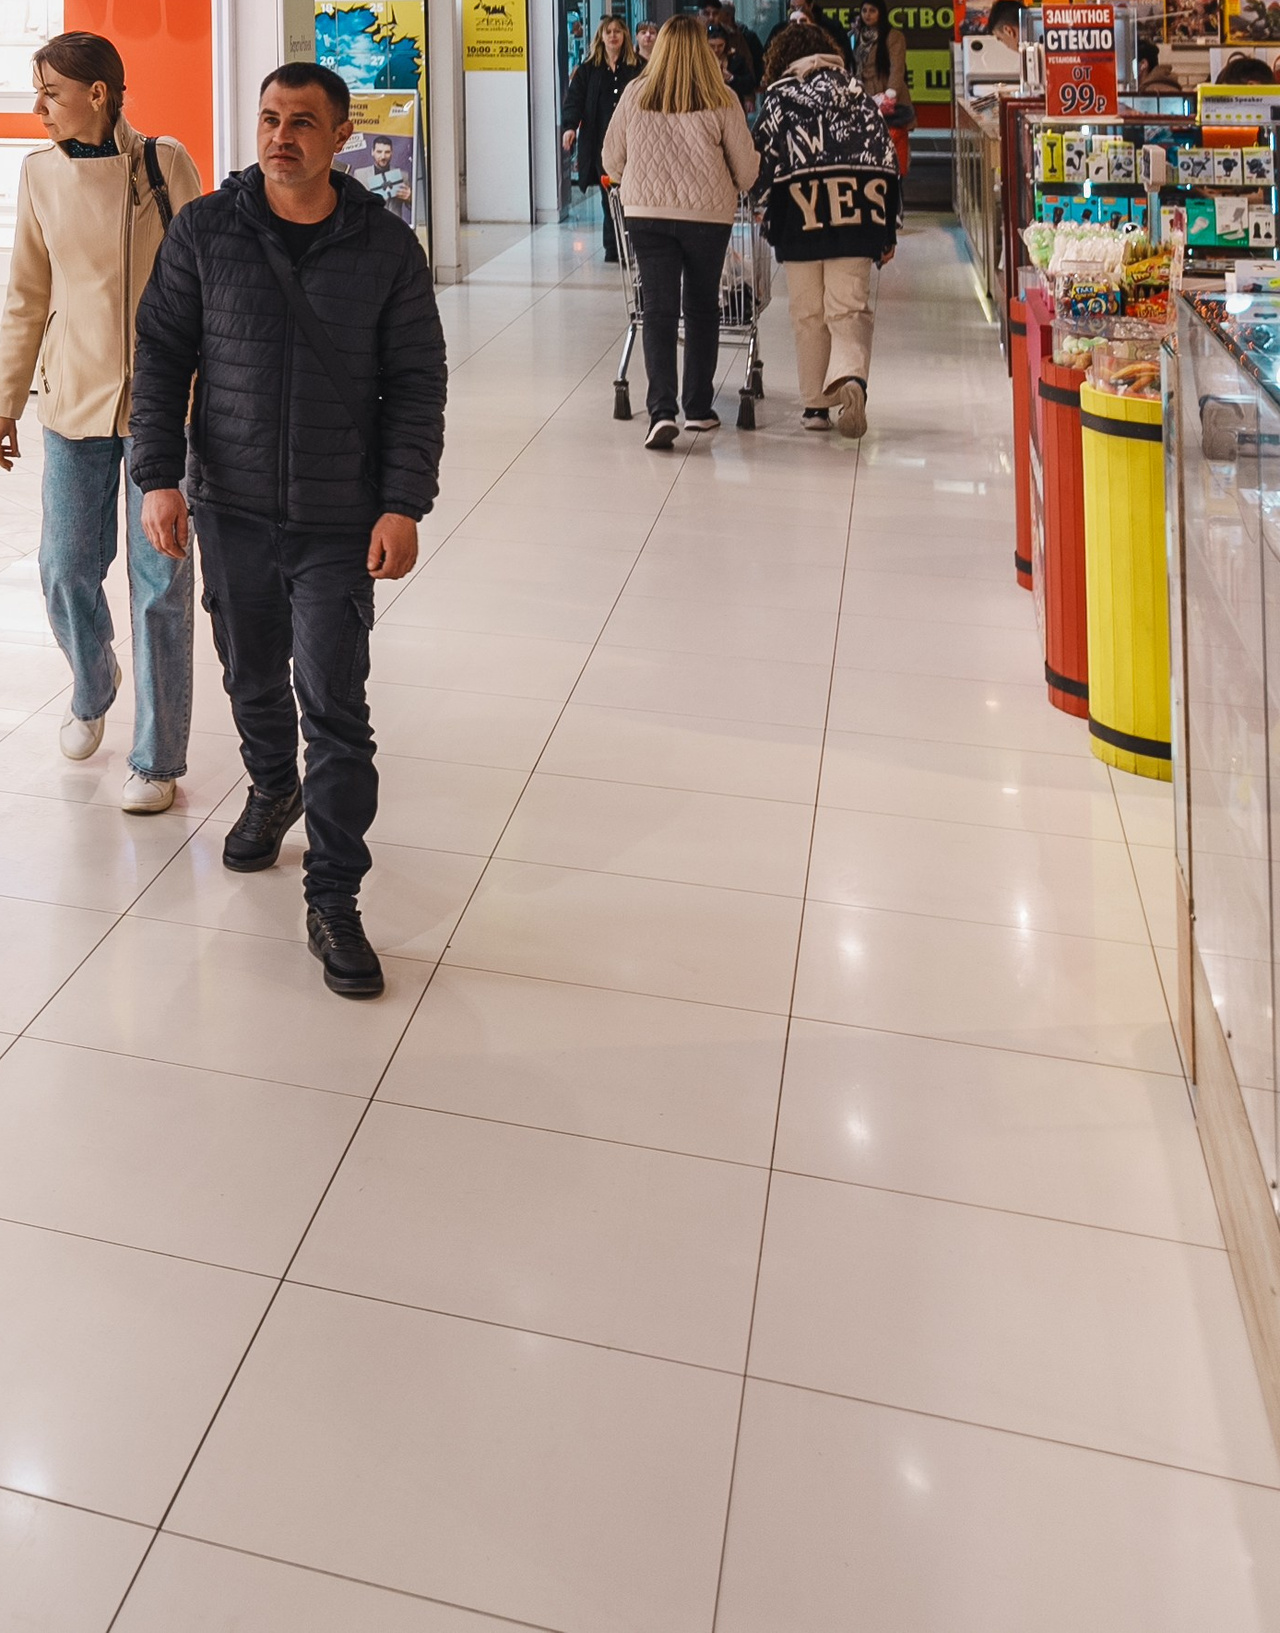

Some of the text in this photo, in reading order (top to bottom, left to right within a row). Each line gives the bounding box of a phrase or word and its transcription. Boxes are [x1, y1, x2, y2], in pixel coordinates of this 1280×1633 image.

[1046, 8, 1110, 24] ЗАЩИТНОЕ
[1047, 29, 1113, 51] СТЕКЛО
[467, 46, 491, 54] 10:00
[499, 46, 524, 54] 22:00
[1071, 65, 1093, 81] ОТ
[788, 176, 888, 232] YES
